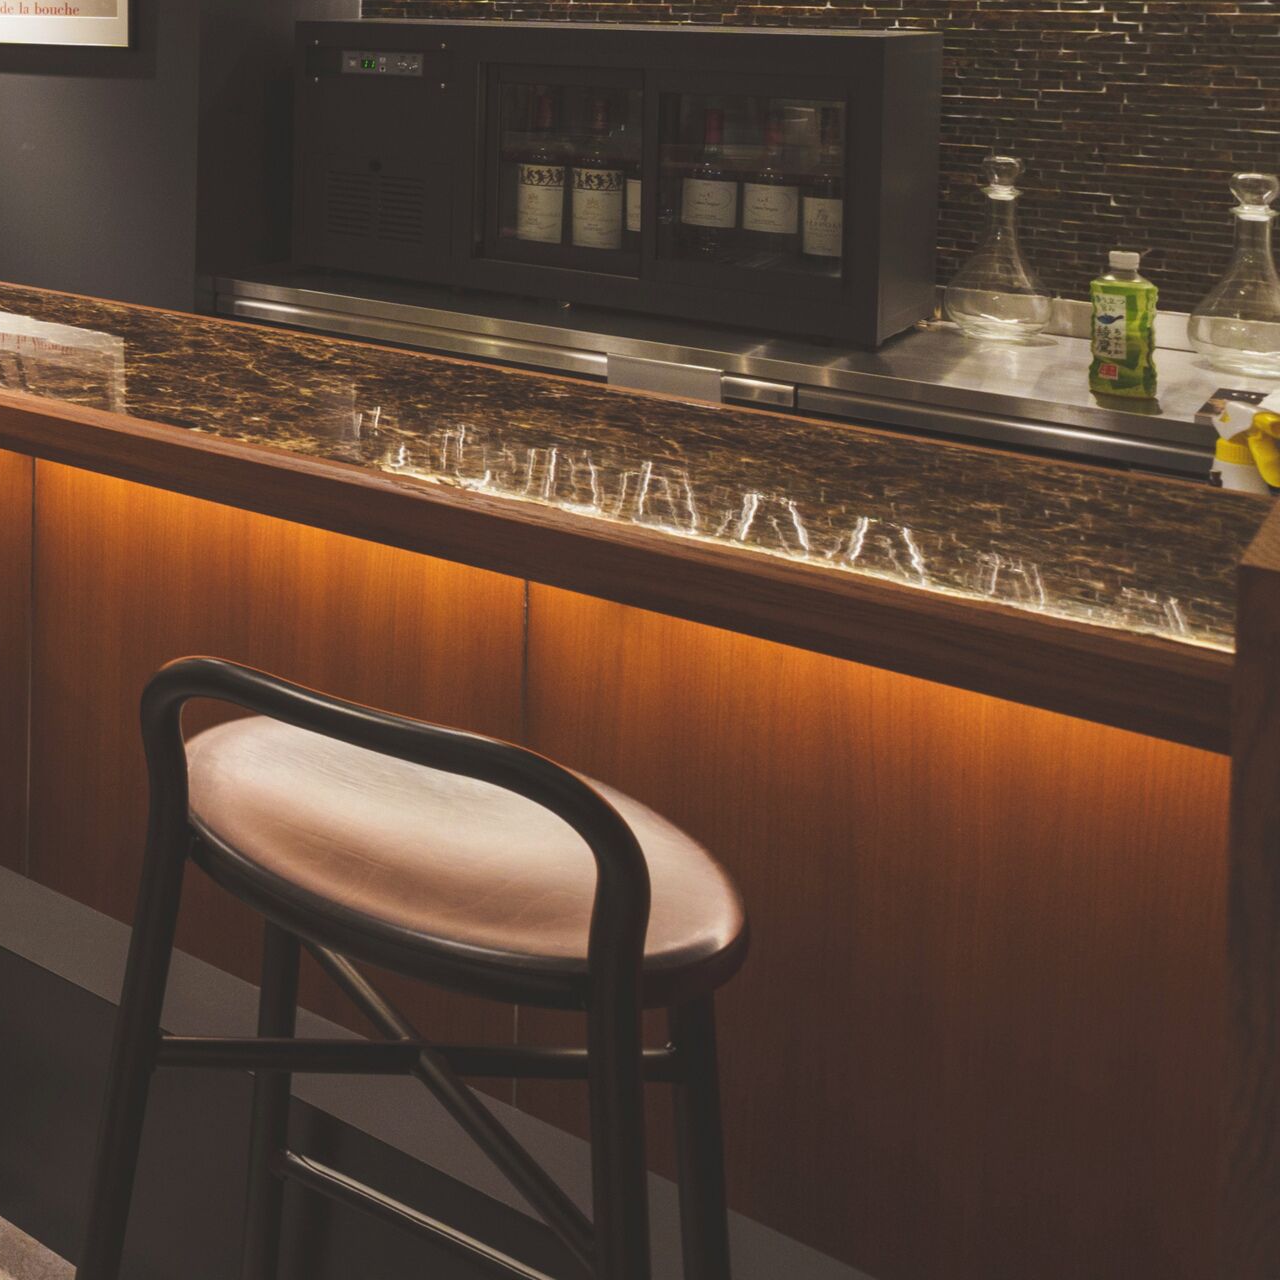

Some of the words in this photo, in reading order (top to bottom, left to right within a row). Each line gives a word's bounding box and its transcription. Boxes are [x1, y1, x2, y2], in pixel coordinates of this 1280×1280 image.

[0, 1, 15, 14] de
[19, 2, 29, 14] la
[34, 2, 80, 16] bouche
